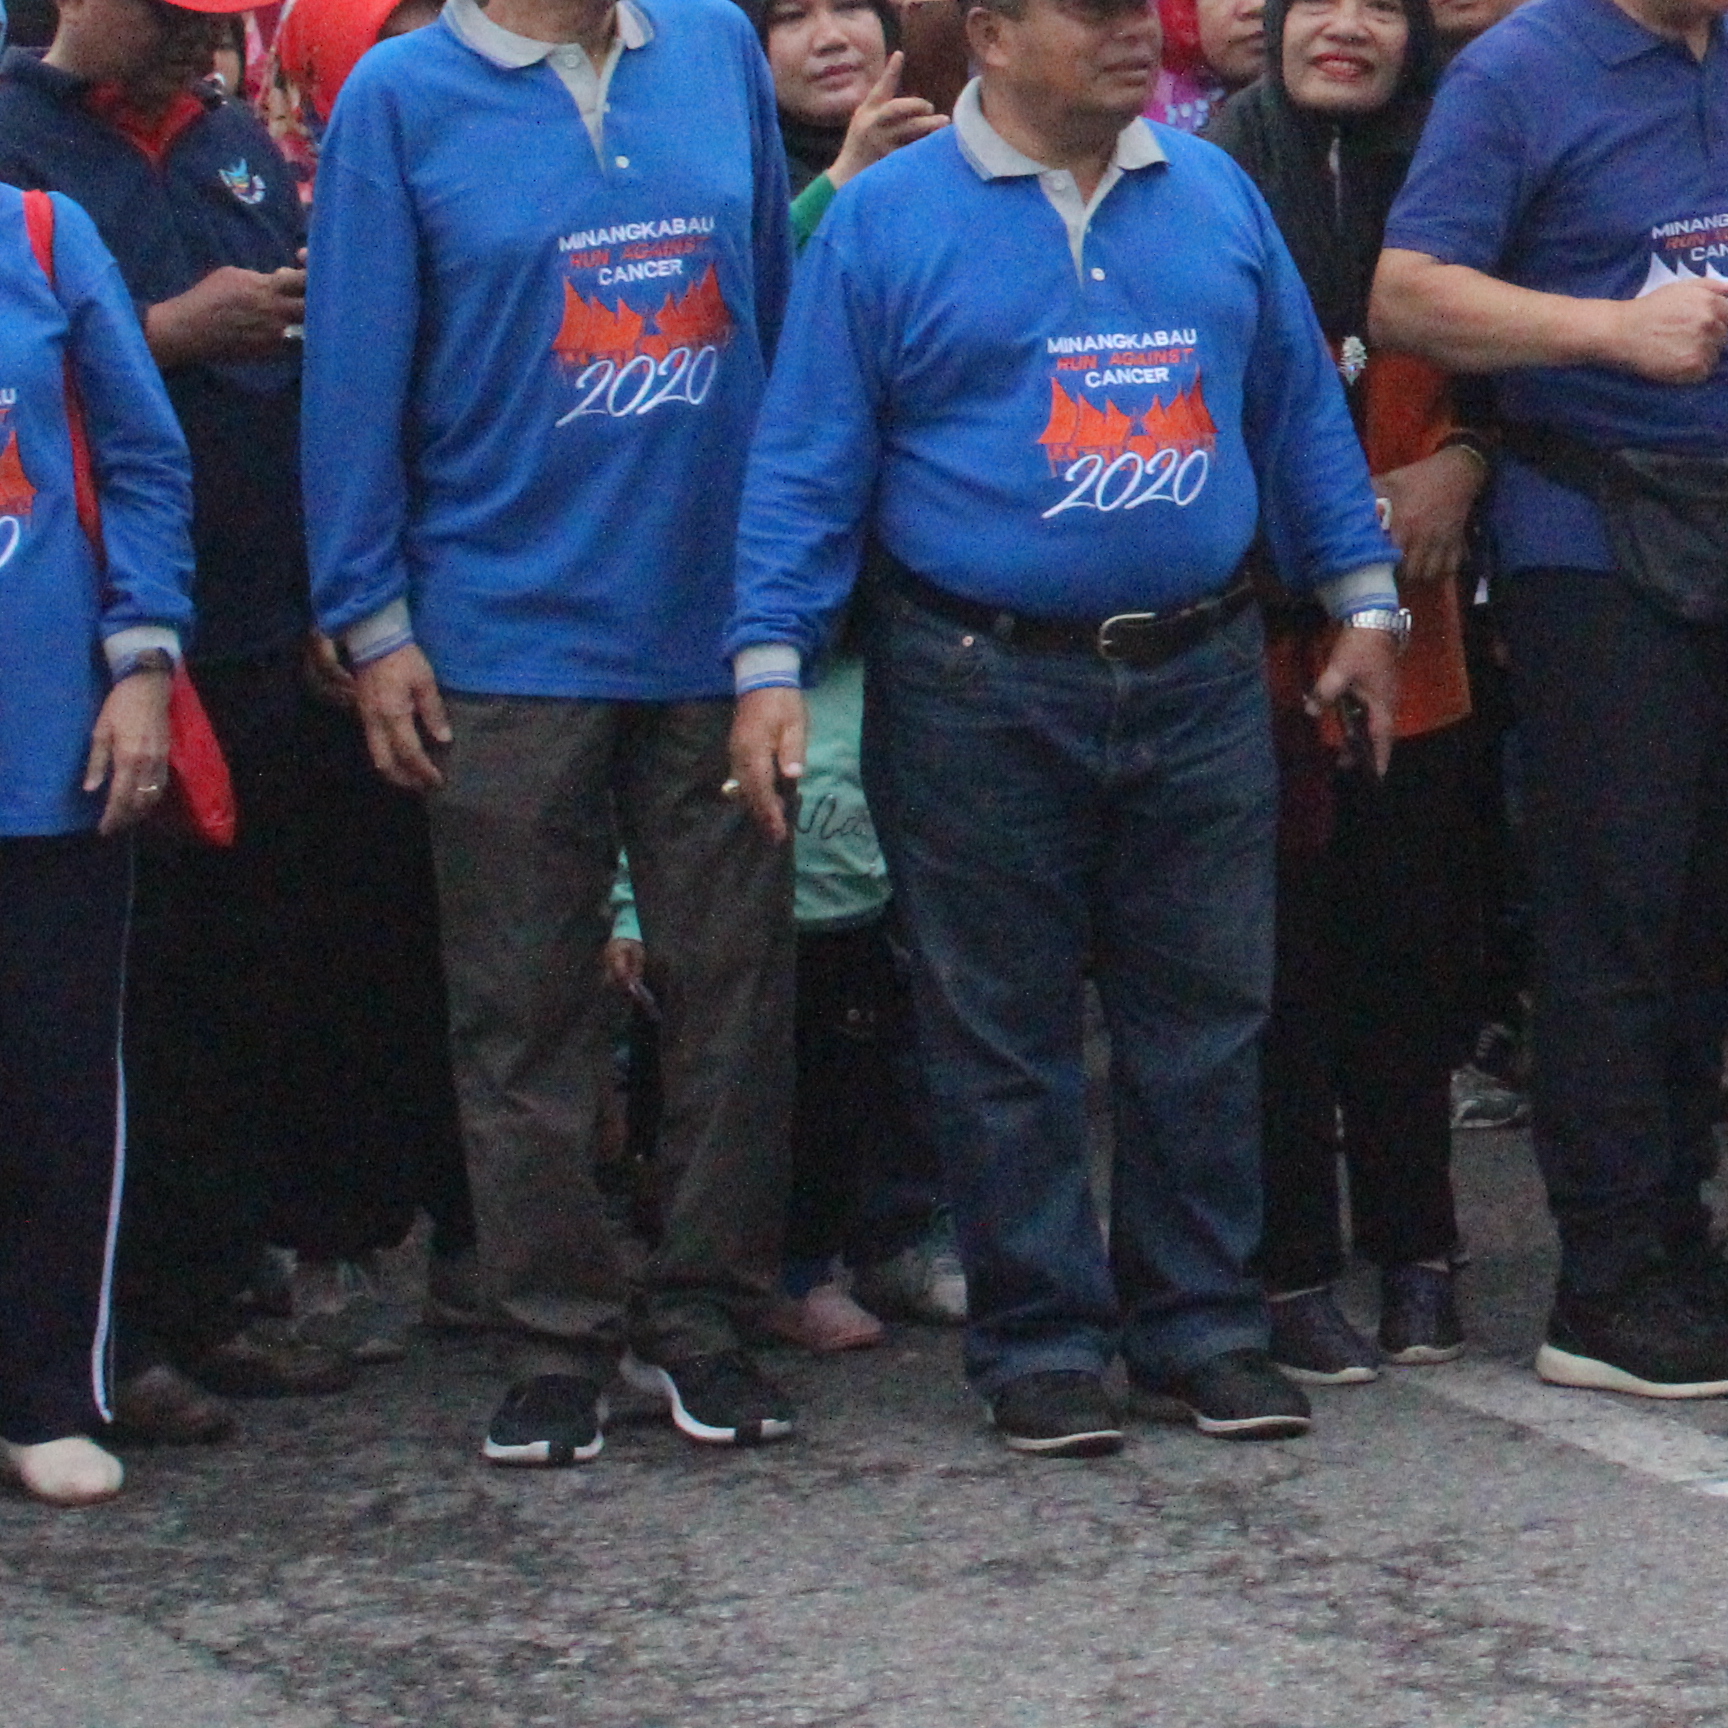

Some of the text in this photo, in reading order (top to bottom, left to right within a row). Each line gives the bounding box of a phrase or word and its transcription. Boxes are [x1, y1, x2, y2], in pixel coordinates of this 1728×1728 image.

[558, 216, 715, 251] MINANGKABAU
[598, 258, 684, 286] CANCER
[1046, 328, 1198, 354] MINANGKABAU
[1056, 347, 1196, 372] RUN AGAINST
[554, 344, 718, 429] 2020
[1085, 366, 1170, 389] CANCER
[1041, 448, 1209, 519] 2020
